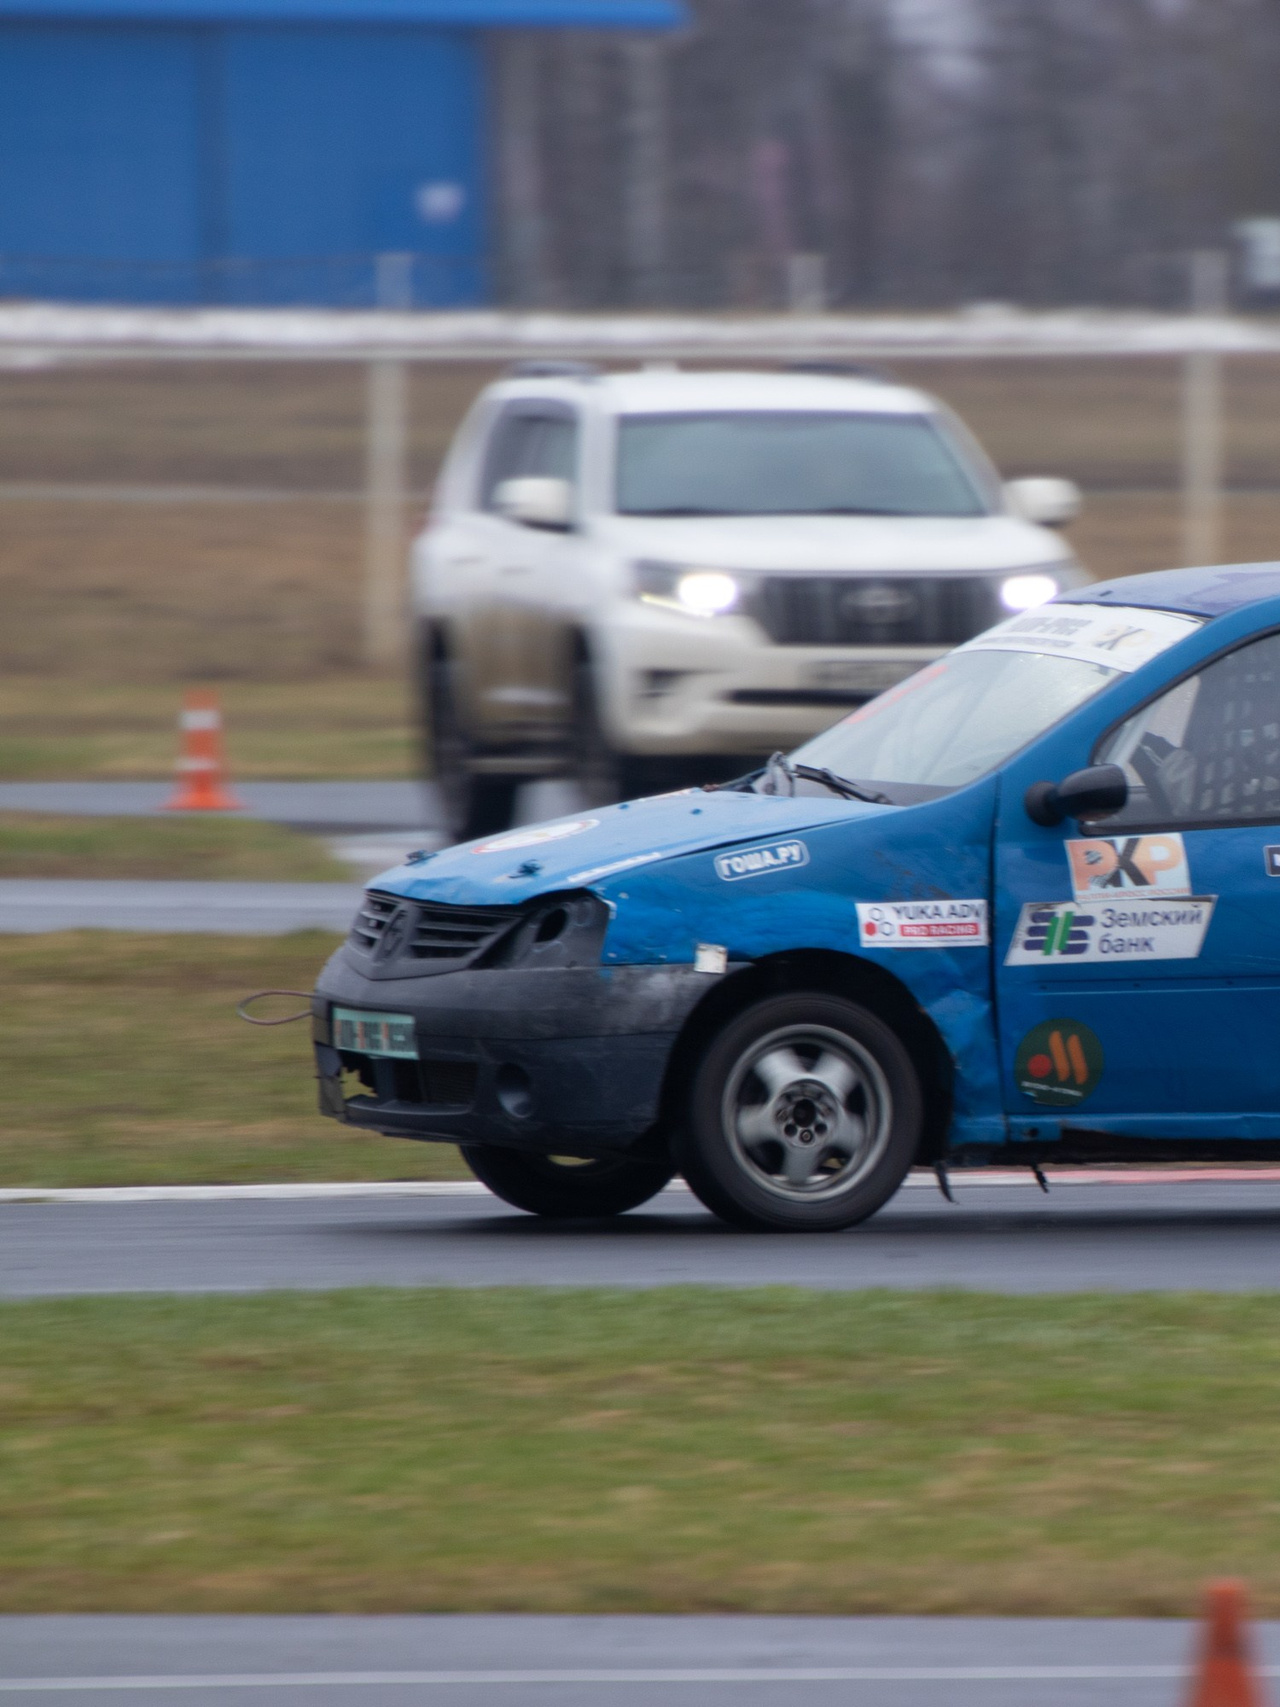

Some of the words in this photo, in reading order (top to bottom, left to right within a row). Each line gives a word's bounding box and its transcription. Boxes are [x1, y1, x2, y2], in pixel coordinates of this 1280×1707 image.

[720, 844, 800, 876] ГОША.РУ
[892, 904, 943, 921] YUKA
[1101, 903, 1203, 929] Земский
[902, 924, 928, 936] PRO
[1099, 934, 1155, 954] банк
